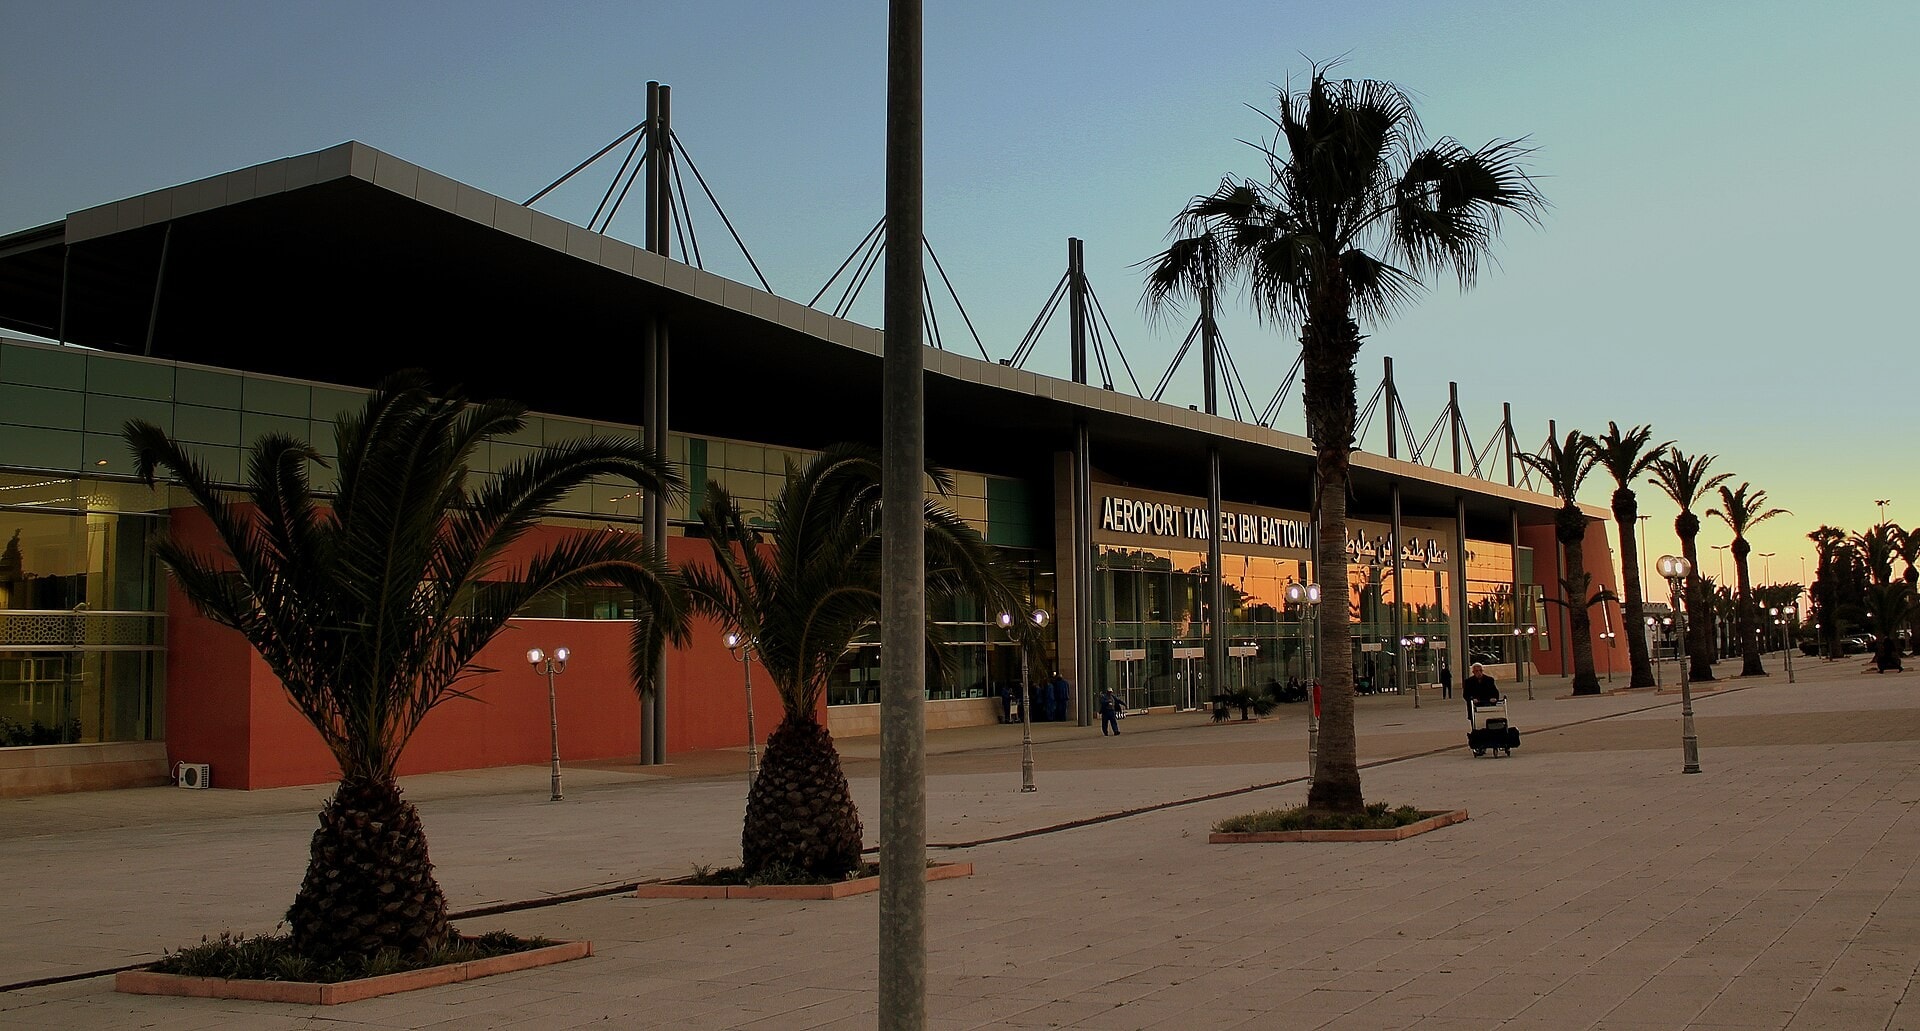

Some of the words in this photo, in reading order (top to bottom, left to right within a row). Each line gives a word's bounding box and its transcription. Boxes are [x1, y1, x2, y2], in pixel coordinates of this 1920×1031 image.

[1102, 496, 1182, 535] AEROPORT
[1184, 507, 1237, 542] TANER
[1239, 513, 1258, 545] IBN
[1345, 527, 1377, 564] بطوط
[1400, 537, 1424, 568] طنج
[1423, 539, 1449, 569] مطار
